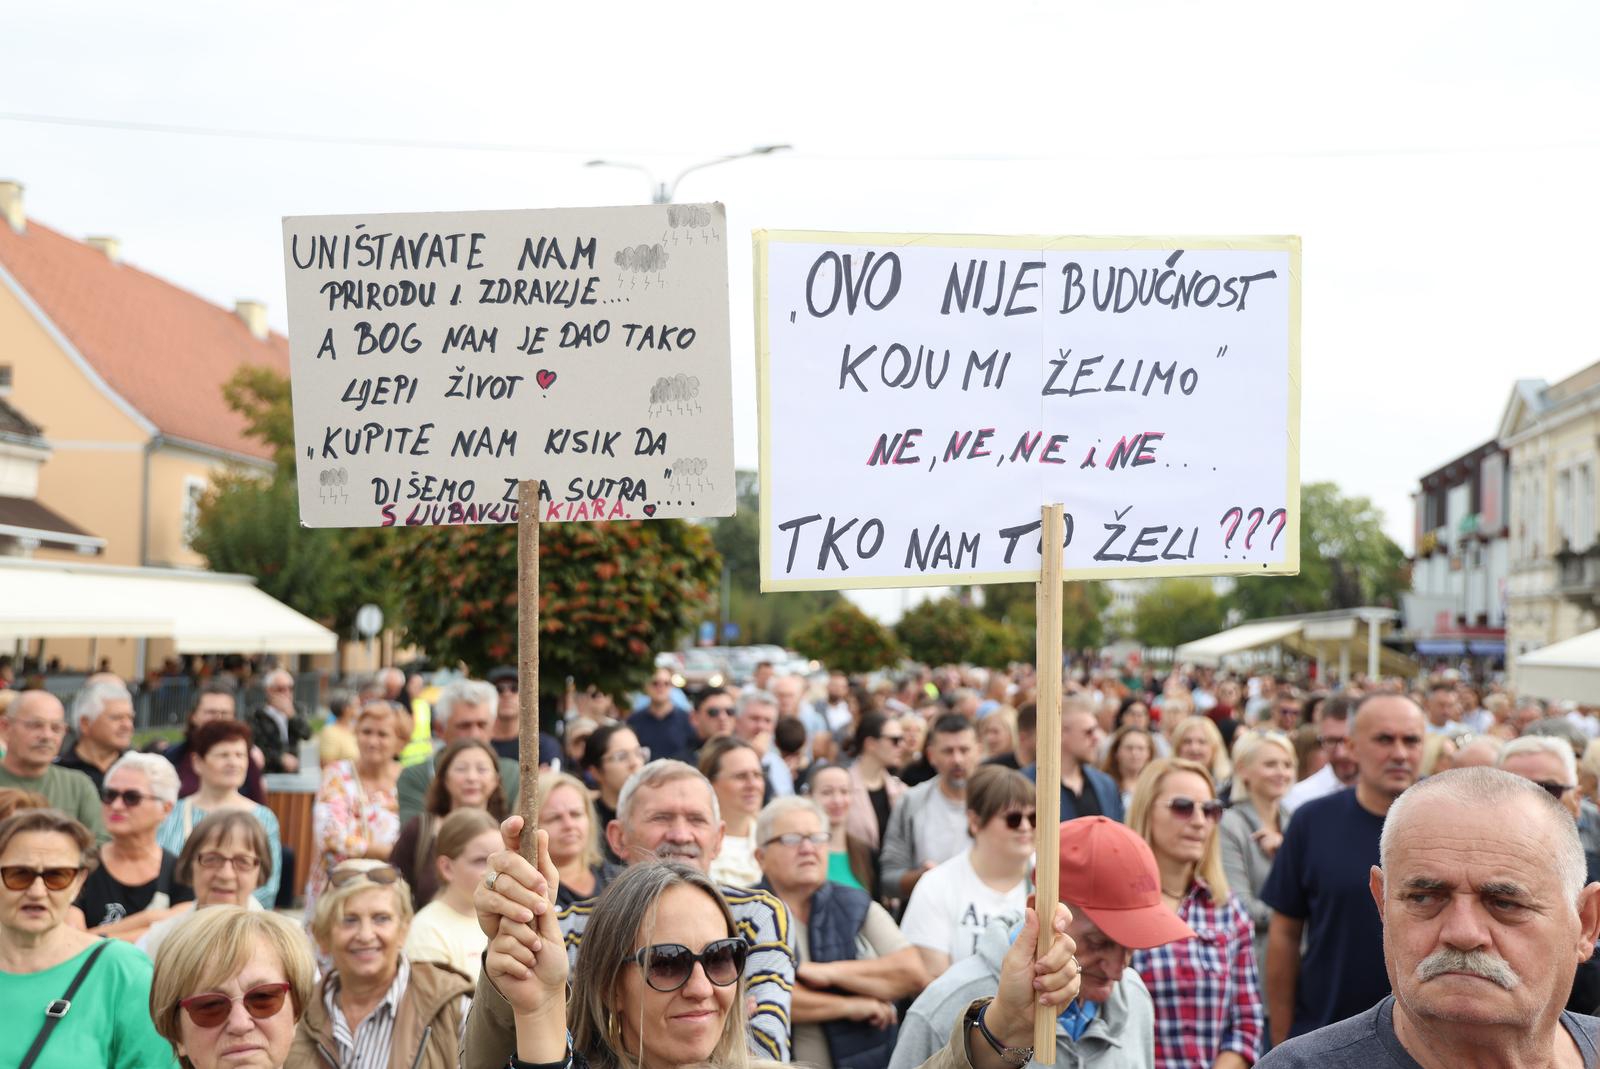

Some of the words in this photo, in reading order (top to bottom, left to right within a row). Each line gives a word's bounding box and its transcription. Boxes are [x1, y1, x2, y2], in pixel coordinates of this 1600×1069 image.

[517, 236, 596, 271] NAM
[320, 280, 436, 311] PRIRODU
[940, 259, 1046, 317] NIJE
[1059, 250, 1277, 314] BUDUĆNOST
[317, 328, 336, 360] A
[354, 322, 422, 355] BOG
[442, 324, 498, 353] NAM
[517, 326, 549, 355] JE
[559, 320, 610, 349] DAO
[622, 324, 696, 351] TAKO
[341, 375, 418, 411] LJEPI
[444, 366, 524, 400] ŽIVOT
[839, 343, 950, 392] KOJU
[962, 349, 1011, 391] MI
[451, 427, 517, 458] NAM
[544, 429, 621, 457] KISIK
[635, 427, 667, 456] DA
[866, 429, 936, 472] NE,
[943, 428, 1004, 467] NE,
[1009, 431, 1069, 464] NE
[381, 503, 397, 527] S
[778, 513, 884, 573] TKO
[904, 524, 980, 572] NAM
[1093, 505, 1198, 562] ŽELI
